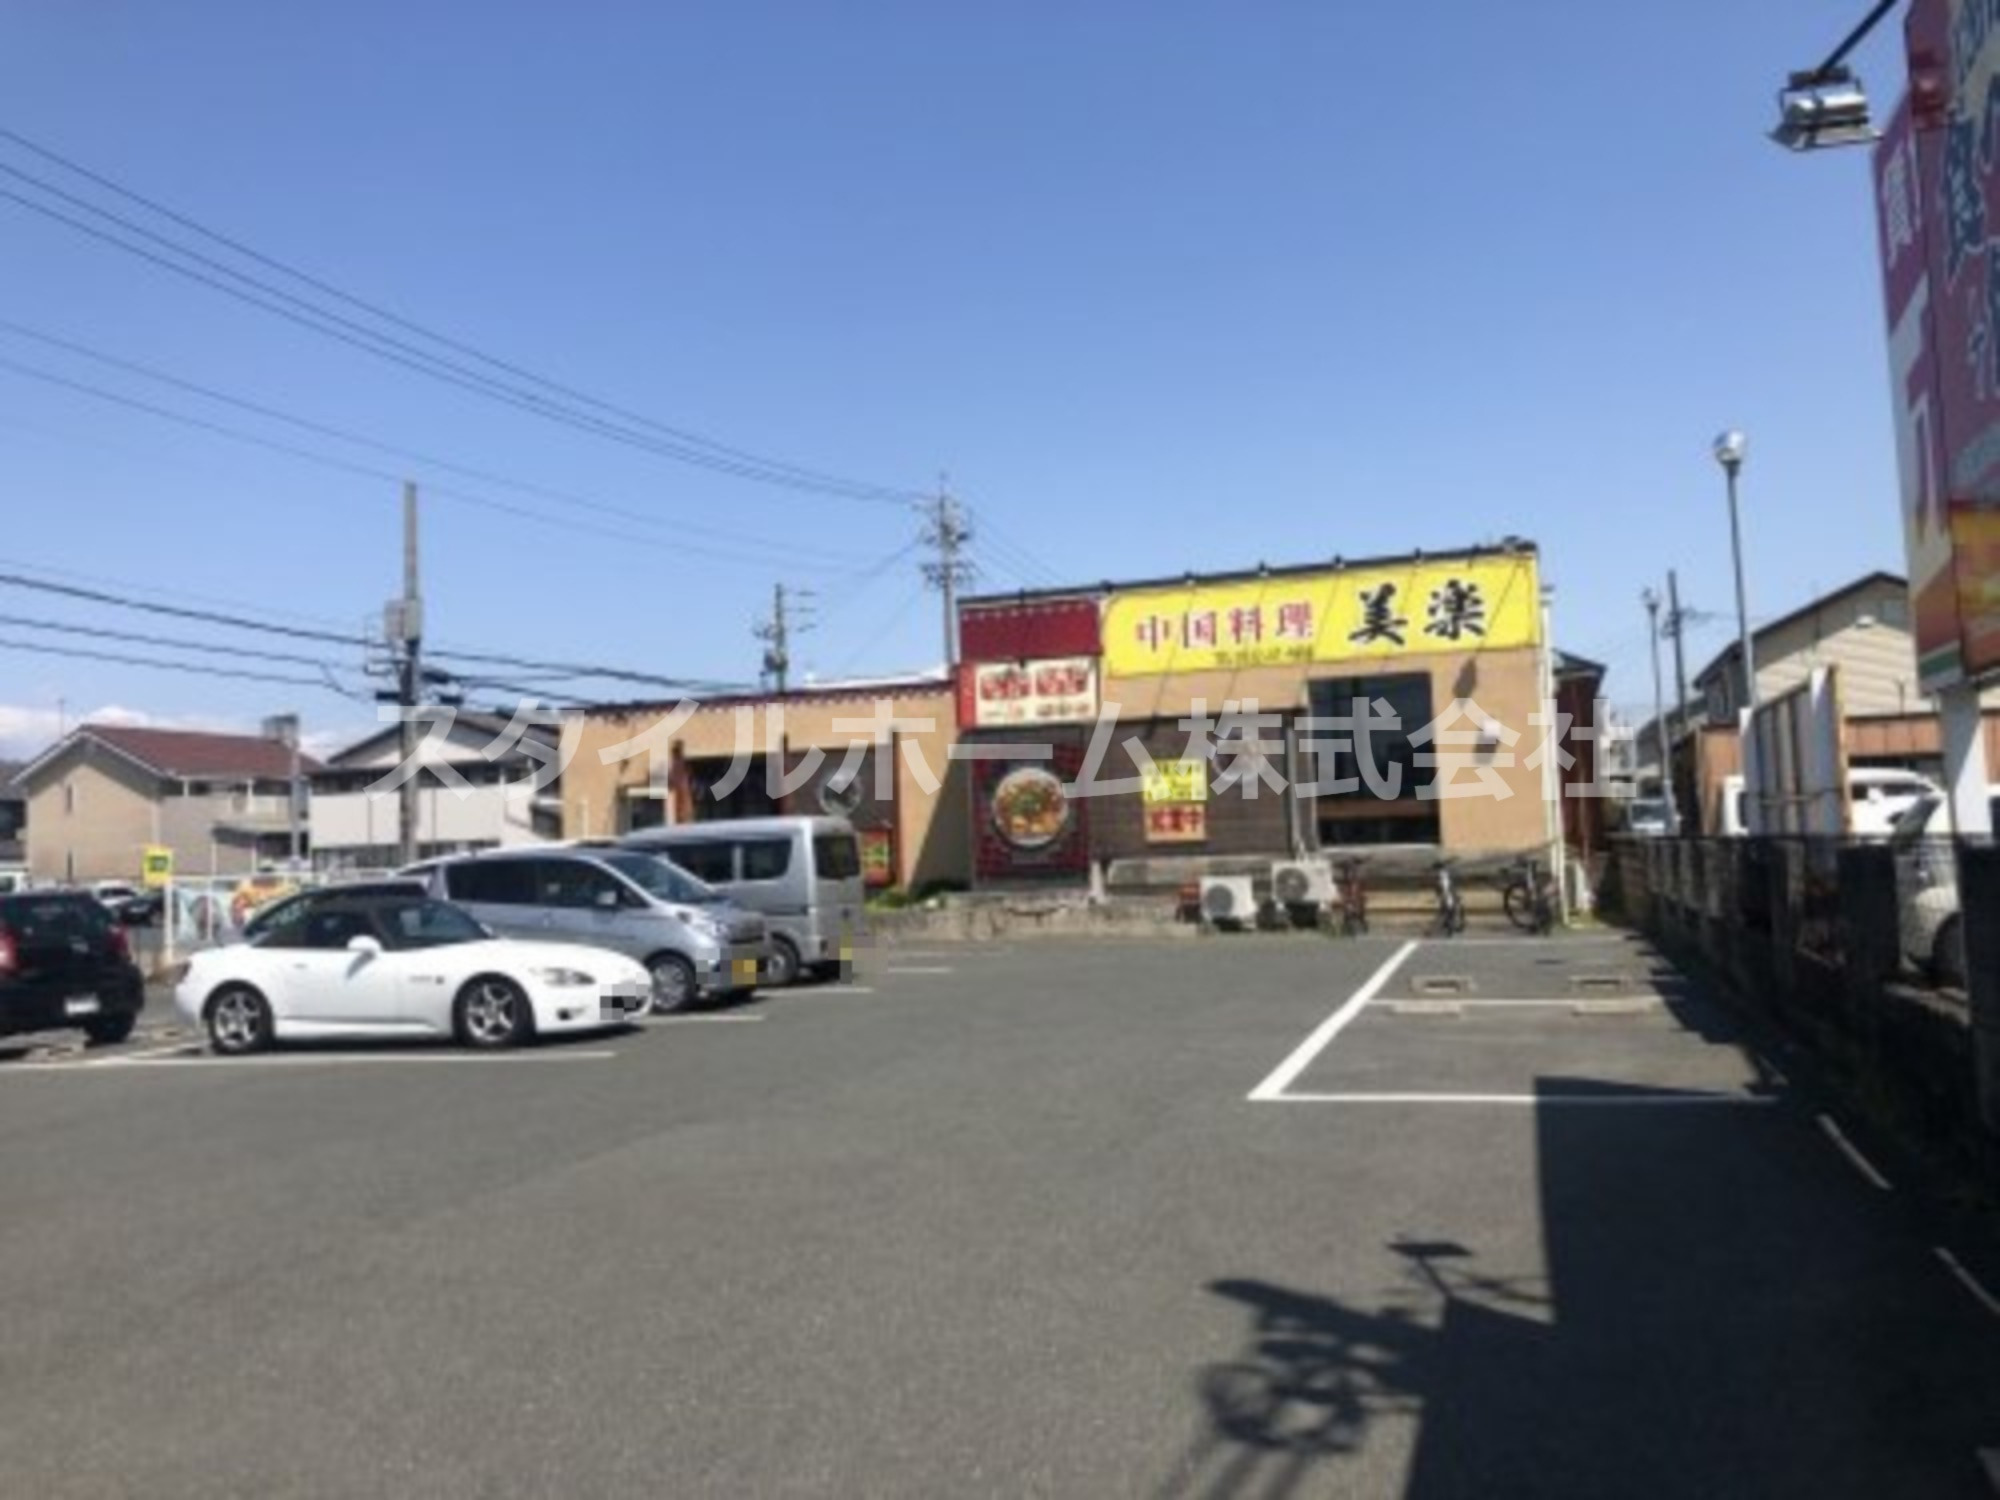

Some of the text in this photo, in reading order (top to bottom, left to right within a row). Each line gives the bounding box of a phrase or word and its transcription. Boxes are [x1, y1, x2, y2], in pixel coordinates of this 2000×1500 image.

[1136, 578, 1486, 652] 中国料理 美楽
